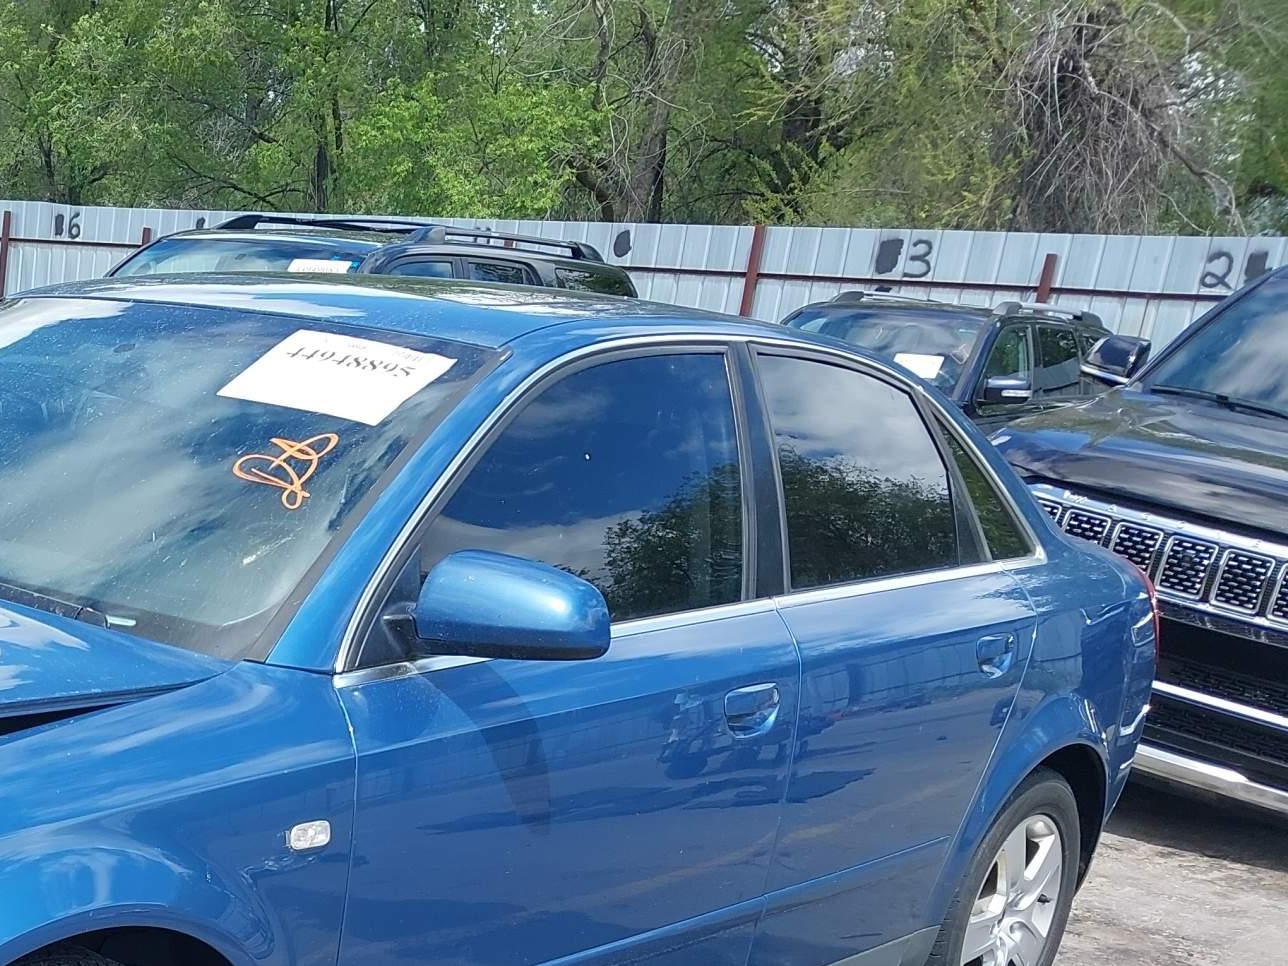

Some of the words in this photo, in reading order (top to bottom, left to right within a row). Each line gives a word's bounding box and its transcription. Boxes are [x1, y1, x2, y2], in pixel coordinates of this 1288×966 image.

[68, 202, 81, 240] 6
[903, 238, 933, 278] 3
[1200, 250, 1234, 289] 2
[286, 346, 416, 378] 44948895
